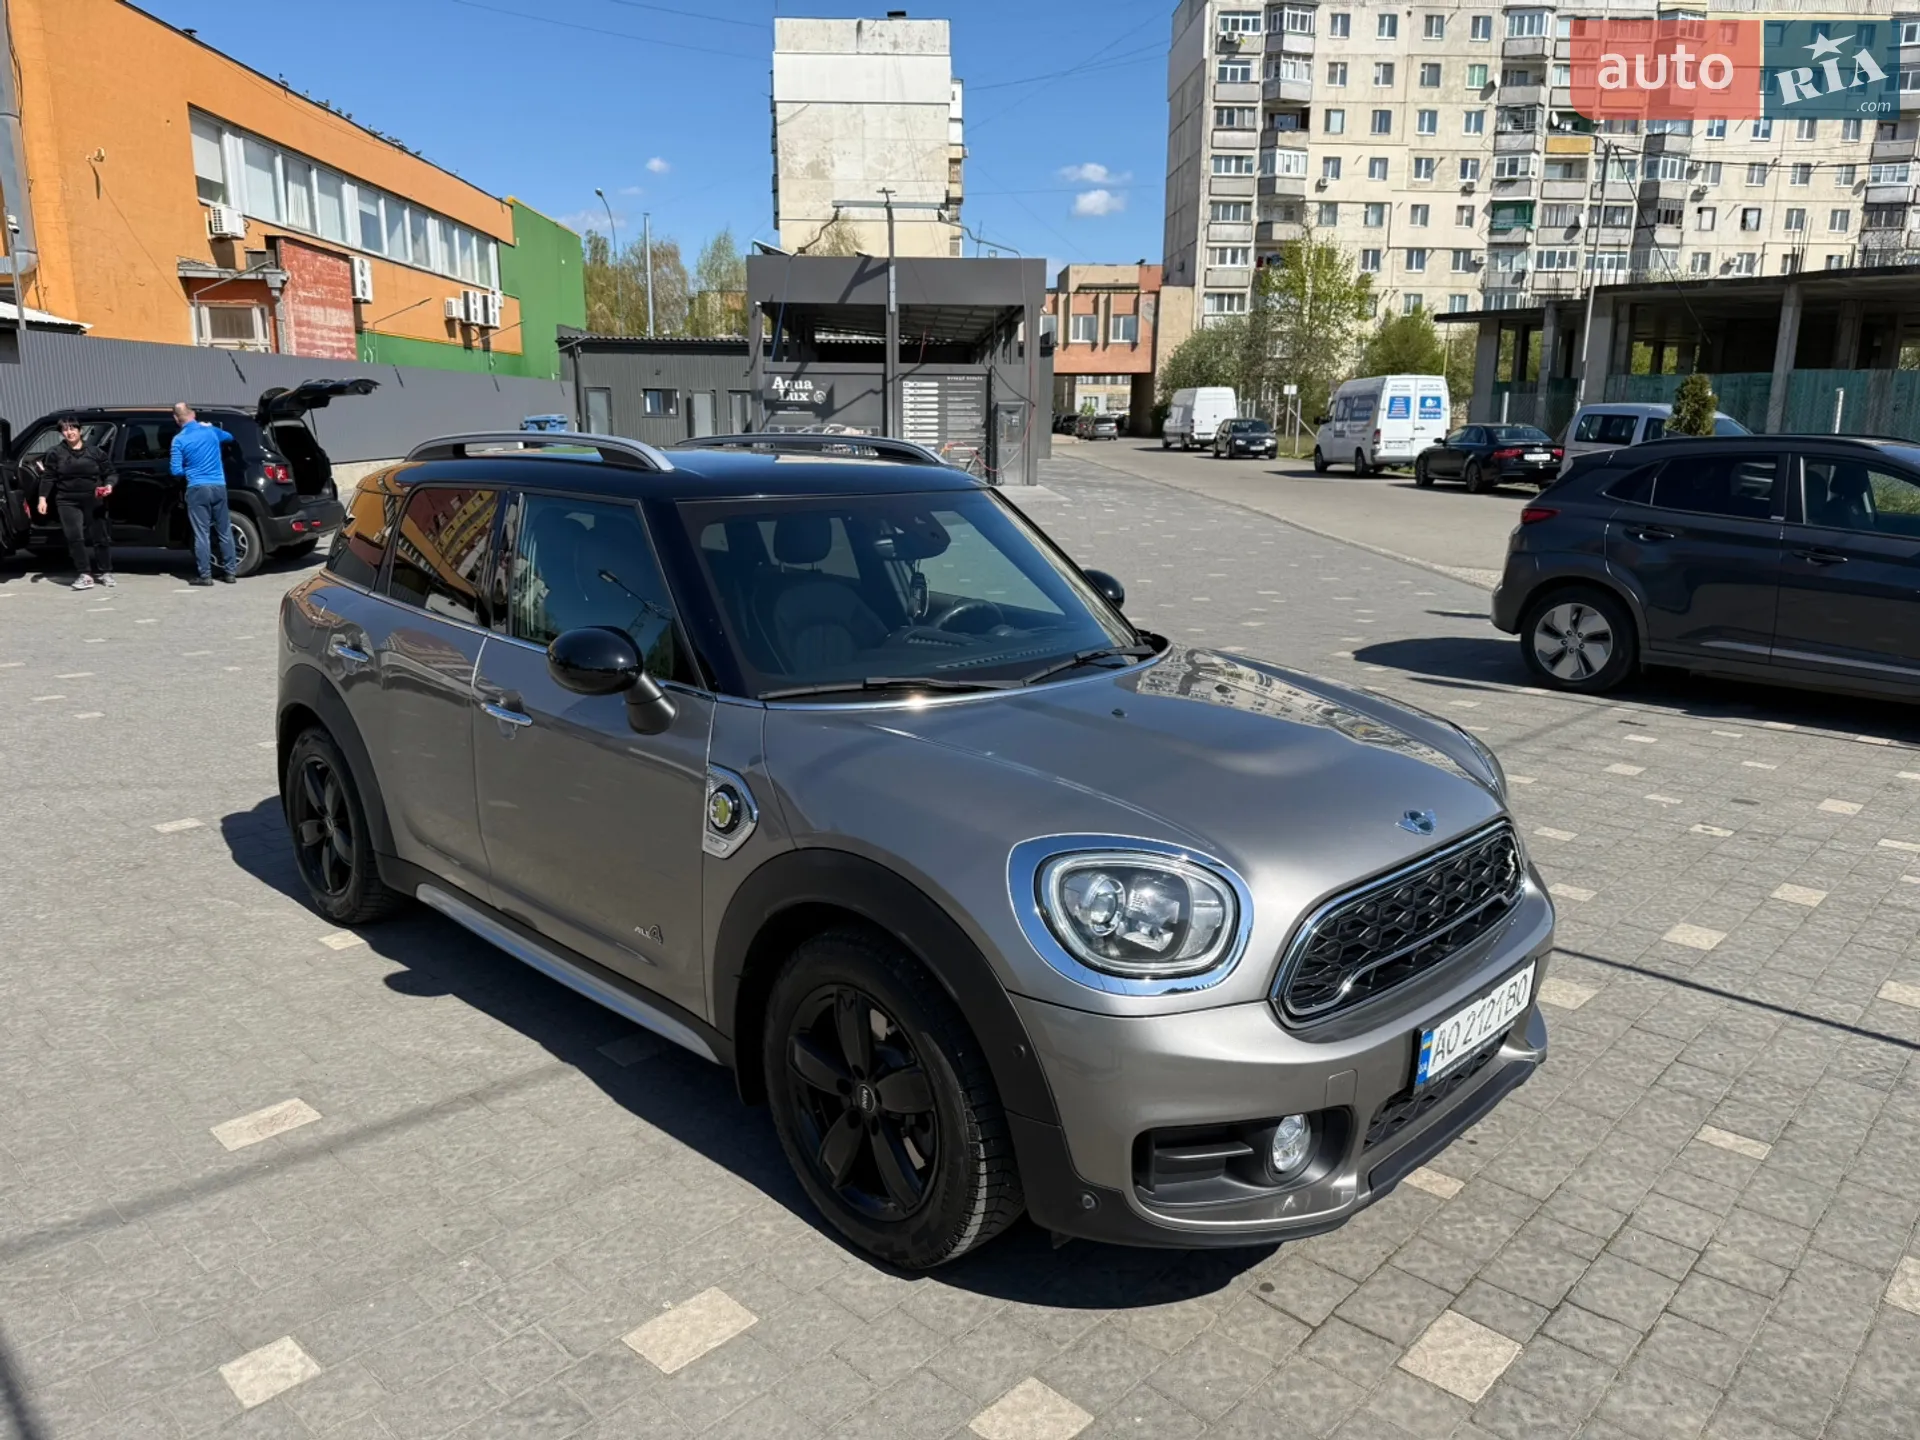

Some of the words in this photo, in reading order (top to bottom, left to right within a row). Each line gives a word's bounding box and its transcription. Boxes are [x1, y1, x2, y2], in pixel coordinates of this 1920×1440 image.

[771, 376, 813, 391] Aqua
[778, 390, 809, 401] Lux
[1431, 1020, 1461, 1067] AO
[1462, 988, 1504, 1045] 2121
[1504, 973, 1528, 1016] BO
